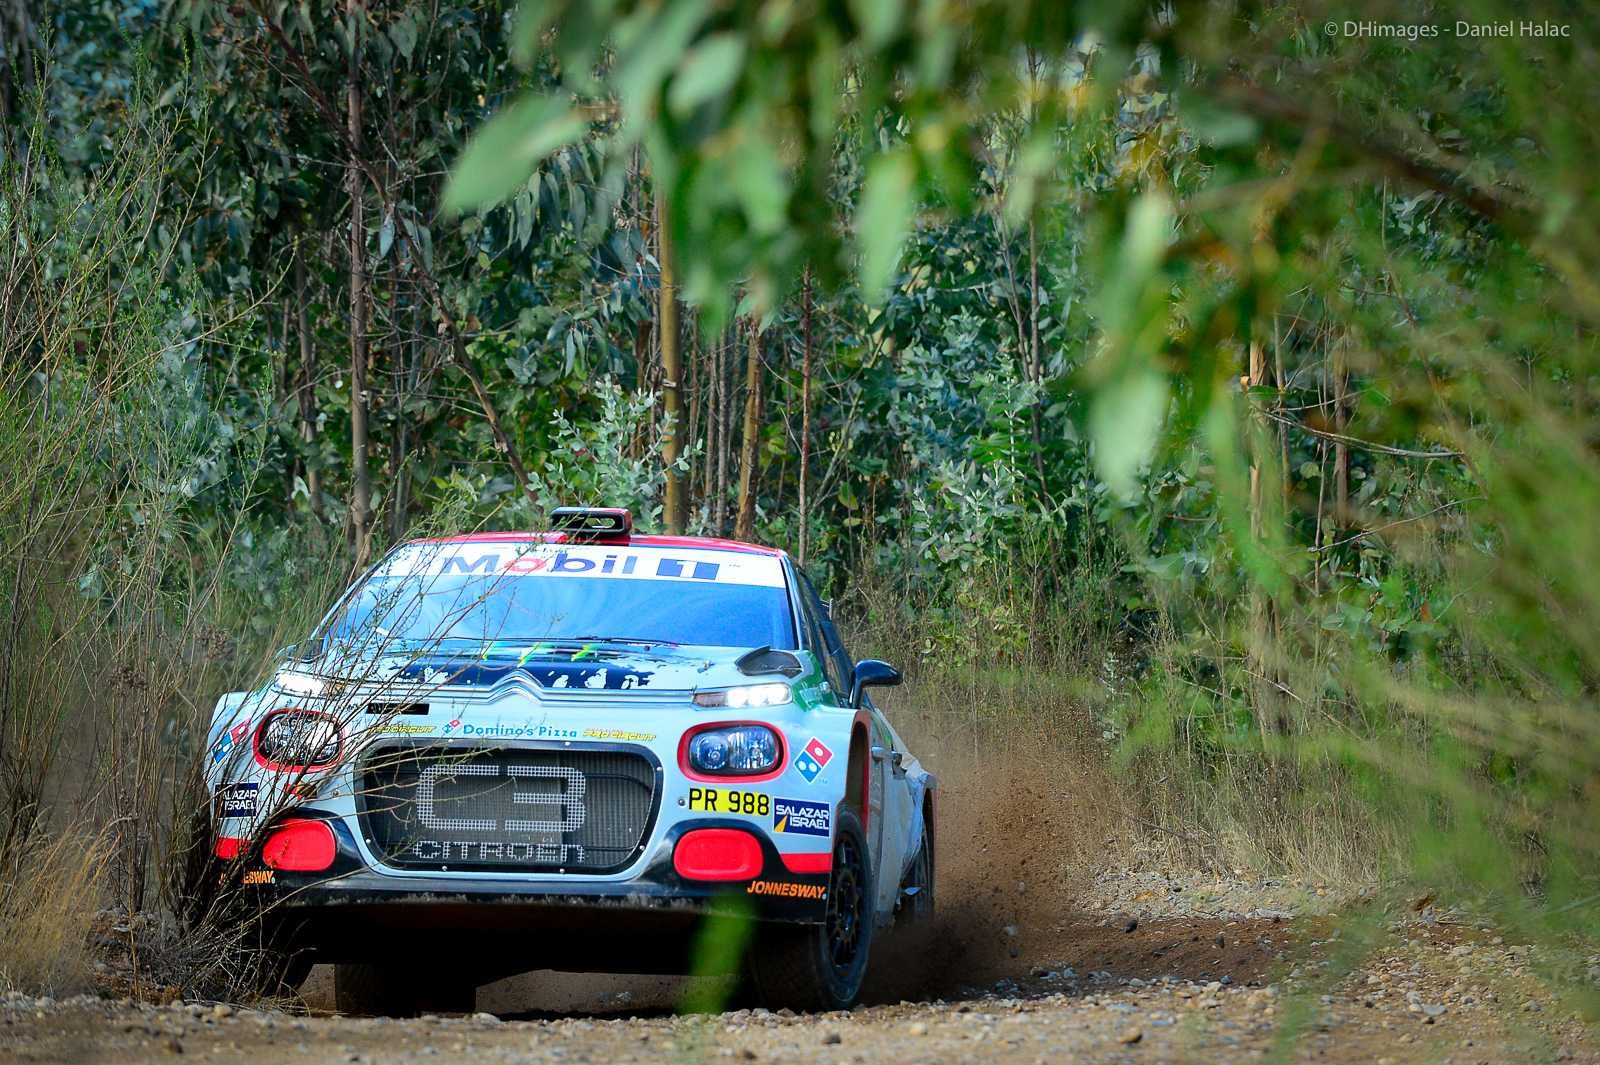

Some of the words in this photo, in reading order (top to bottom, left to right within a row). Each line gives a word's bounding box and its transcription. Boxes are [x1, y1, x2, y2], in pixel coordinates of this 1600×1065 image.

[440, 553, 638, 575] Mobil
[463, 724, 534, 736] Domino's
[538, 726, 577, 738] Pizza
[583, 730, 610, 739] PRO
[610, 731, 657, 741] CIRCUIT
[416, 764, 586, 832] C3
[689, 788, 718, 811] PR
[728, 791, 769, 816] 988
[776, 804, 830, 820] SALAZAR
[789, 816, 829, 830] ISRAEL
